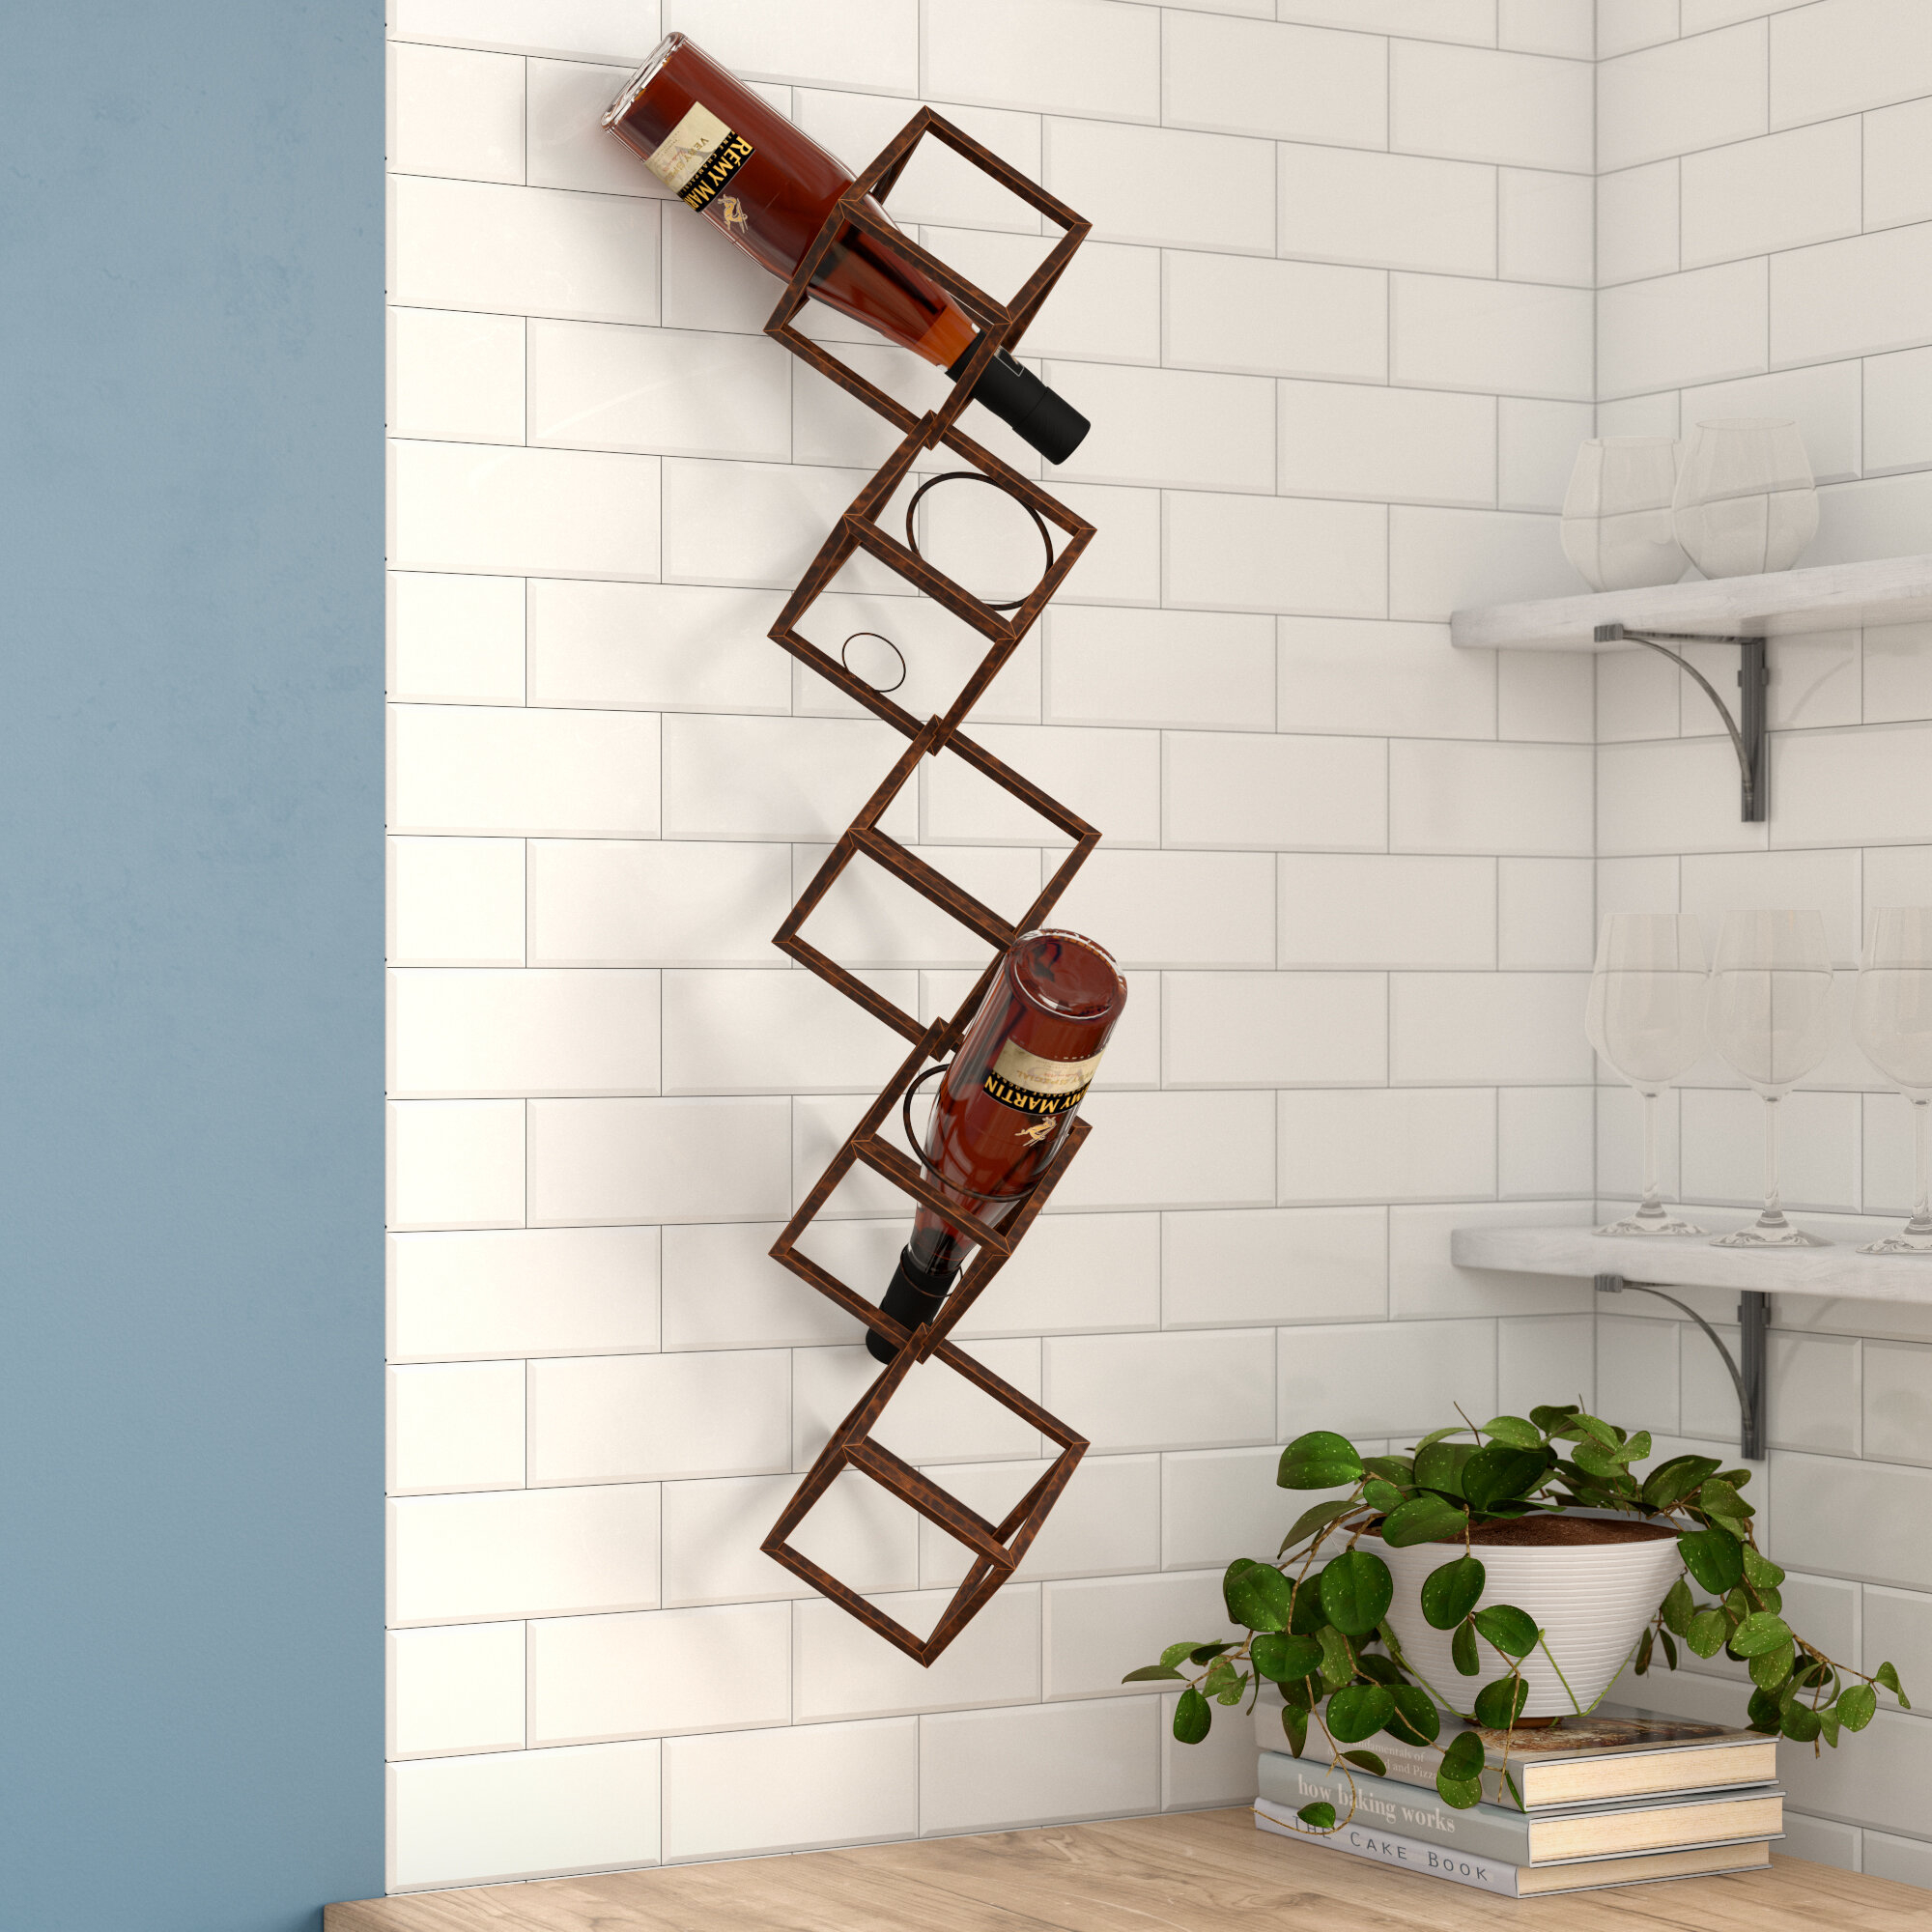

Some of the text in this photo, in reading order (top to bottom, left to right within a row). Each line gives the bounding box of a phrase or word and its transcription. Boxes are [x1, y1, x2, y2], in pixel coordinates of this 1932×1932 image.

[683, 136, 753, 211] RÉMY MAR
[984, 1075, 1059, 1114] MARTIN
[1350, 1740, 1412, 1758] undamentals
[1413, 1751, 1426, 1762] of
[1392, 1763, 1410, 1775] and
[1297, 1773, 1456, 1833] how baking works
[1350, 1832, 1407, 1861] CAKE
[1428, 1851, 1488, 1882] BOOK
